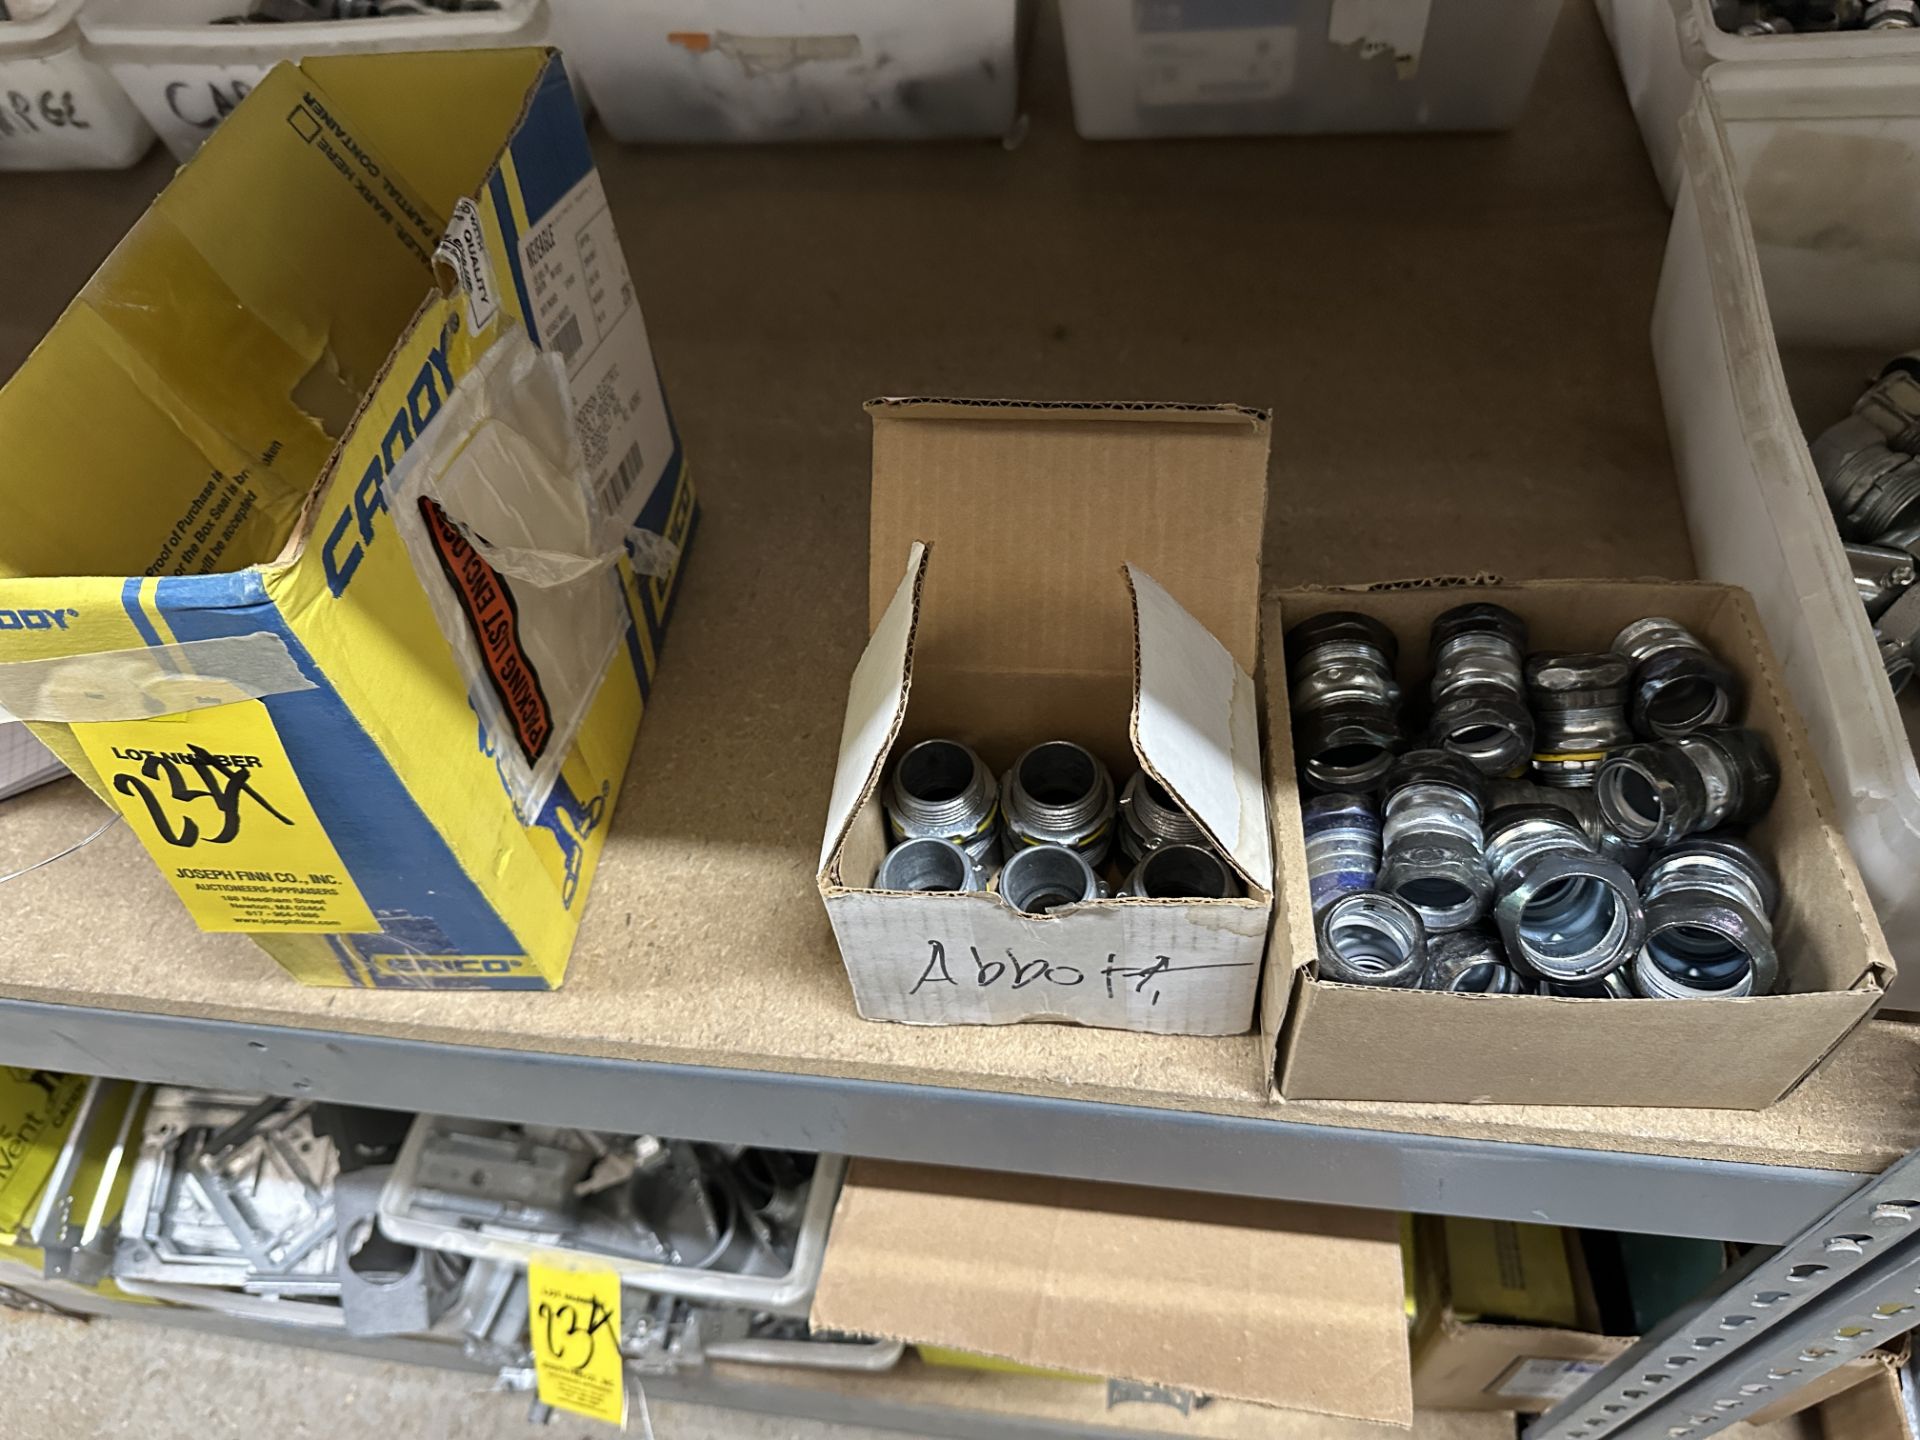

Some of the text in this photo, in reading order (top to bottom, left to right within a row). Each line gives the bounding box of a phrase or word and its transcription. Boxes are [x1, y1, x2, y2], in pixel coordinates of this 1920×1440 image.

[302, 91, 434, 237] PARTIAL CONTAINER
[316, 138, 356, 182] HERE
[355, 180, 394, 225] MARK
[463, 229, 490, 305] QUALITY
[145, 544, 173, 576] Proof
[169, 529, 183, 548] of
[176, 480, 217, 534] Purchase
[173, 562, 186, 577] or
[181, 542, 200, 564] the
[194, 519, 215, 544] Box
[209, 492, 232, 521] Seal
[226, 482, 239, 497] is
[212, 539, 226, 558] be
[223, 490, 258, 542] accepted
[482, 608, 511, 662] LIST
[500, 654, 544, 747] PACKING
[111, 746, 263, 768] LOT NUBER
[175, 867, 233, 880] JOSEPH
[235, 870, 274, 882] FINN
[309, 873, 343, 885] INC.
